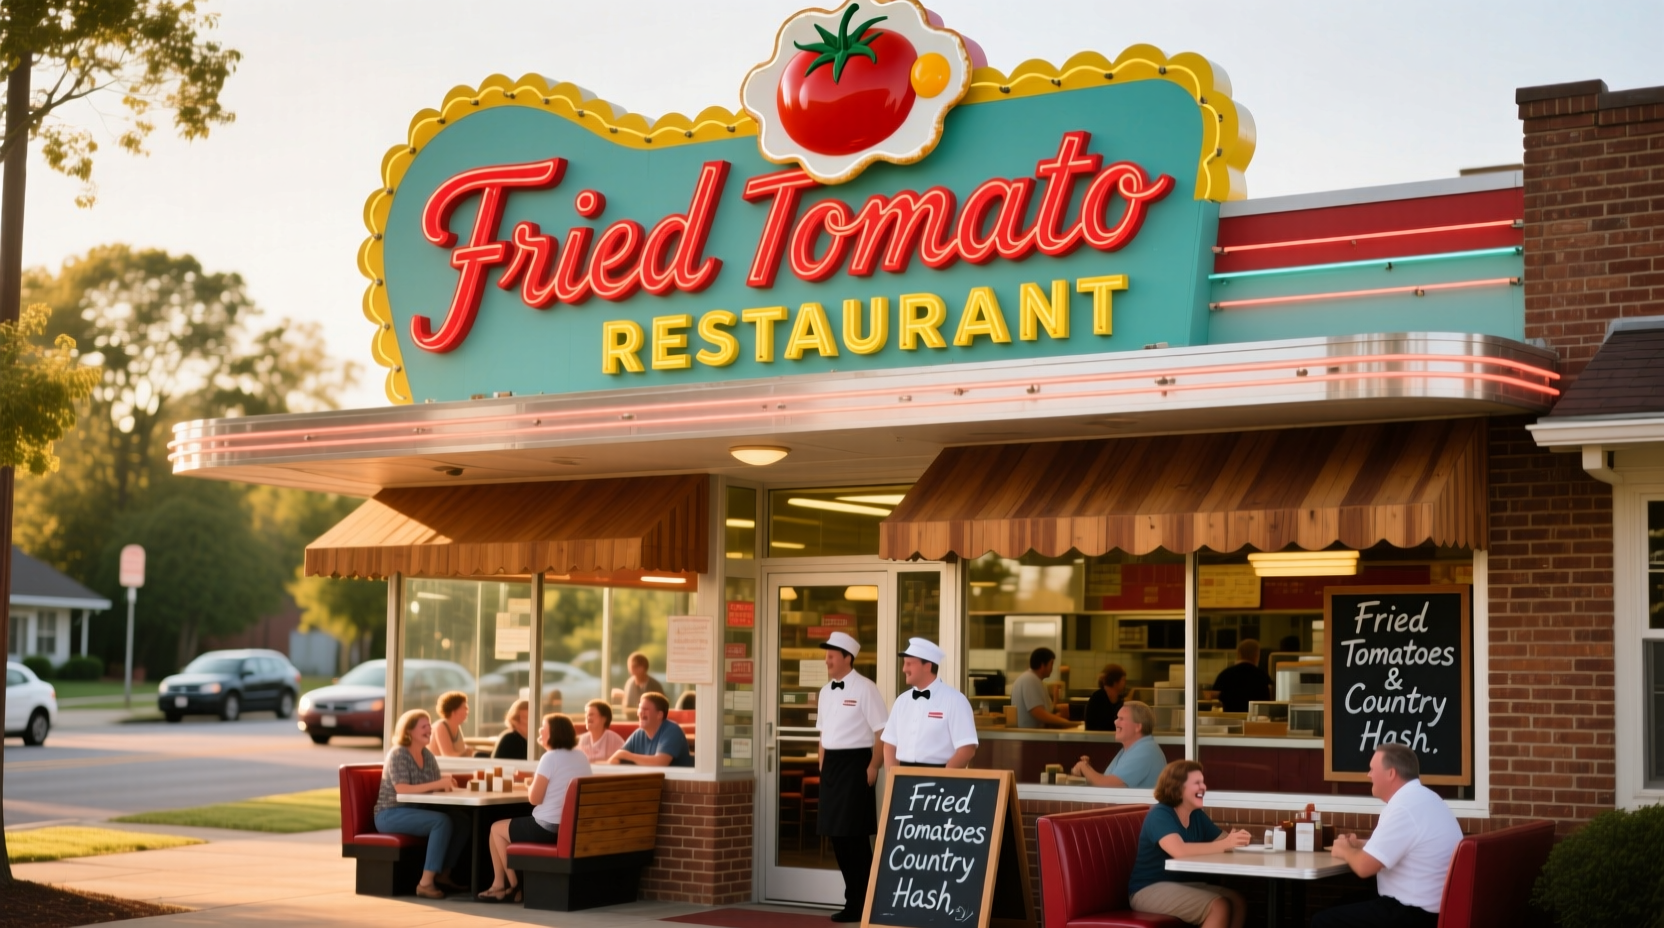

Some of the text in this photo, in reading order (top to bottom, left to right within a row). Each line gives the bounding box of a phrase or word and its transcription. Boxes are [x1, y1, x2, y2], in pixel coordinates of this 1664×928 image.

[410, 130, 1176, 354] Fried Tomato
[602, 273, 1129, 375] RESTAURANT
[1354, 600, 1430, 634] Fried
[1340, 638, 1455, 667] Tomatoes
[1384, 667, 1404, 690] &
[1344, 682, 1447, 727] Country
[1359, 719, 1438, 754] Hash.
[908, 782, 975, 814] Fried
[893, 815, 987, 844] Tomatoes
[888, 845, 976, 883] Country
